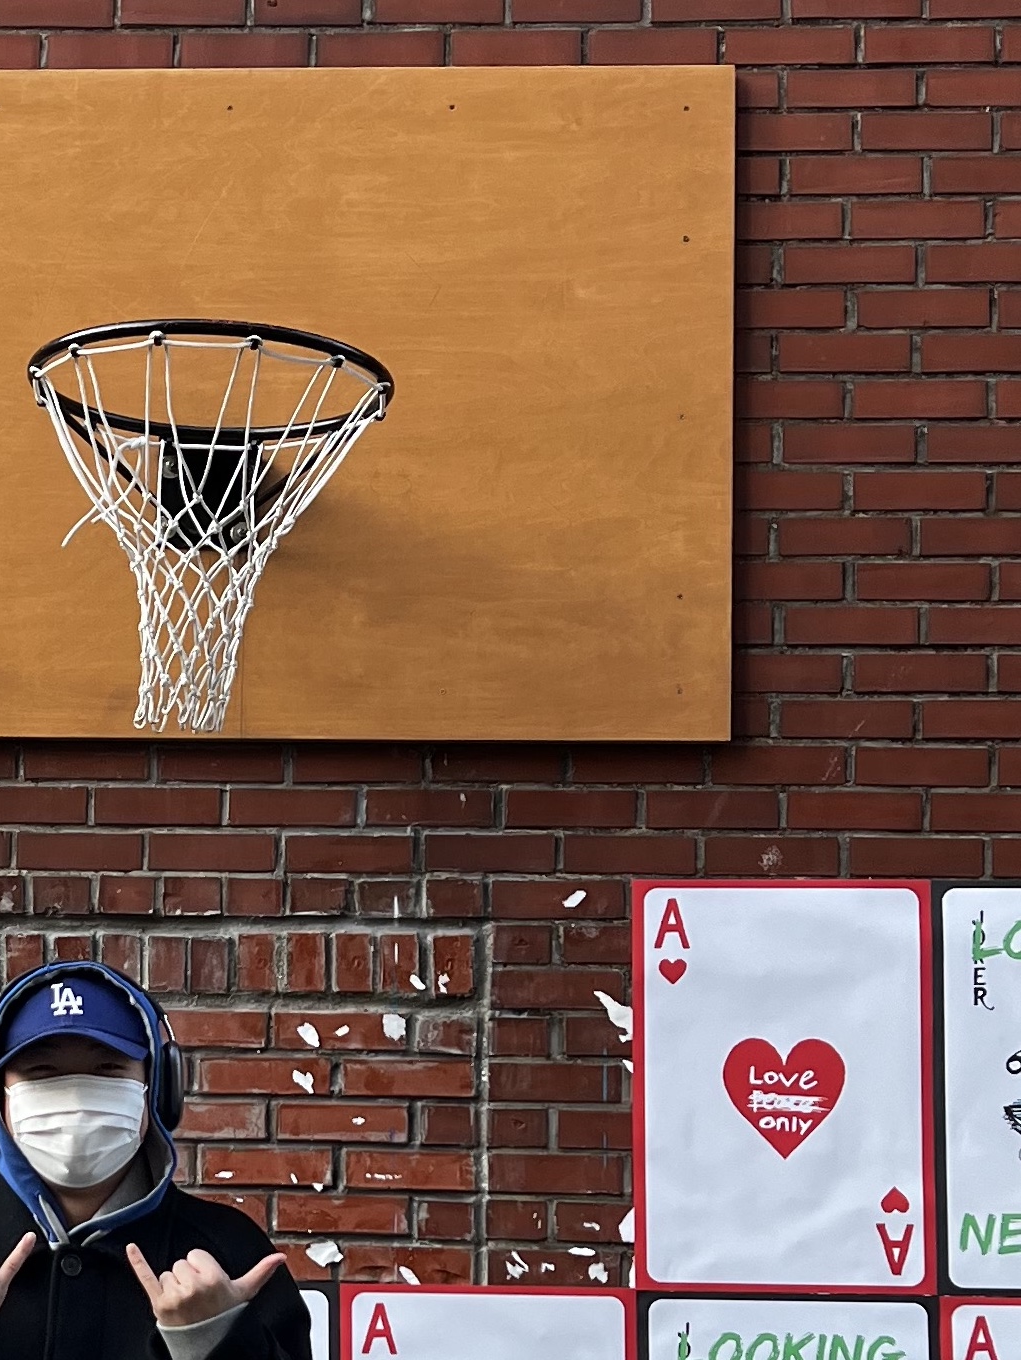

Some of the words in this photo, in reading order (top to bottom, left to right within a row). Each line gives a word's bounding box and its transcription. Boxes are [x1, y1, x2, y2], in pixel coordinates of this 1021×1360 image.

[653, 897, 691, 950] A
[50, 982, 84, 1016] LA
[748, 1065, 818, 1091] Love
[758, 1115, 814, 1137] only
[875, 1222, 915, 1276] A
[361, 1302, 398, 1356] A
